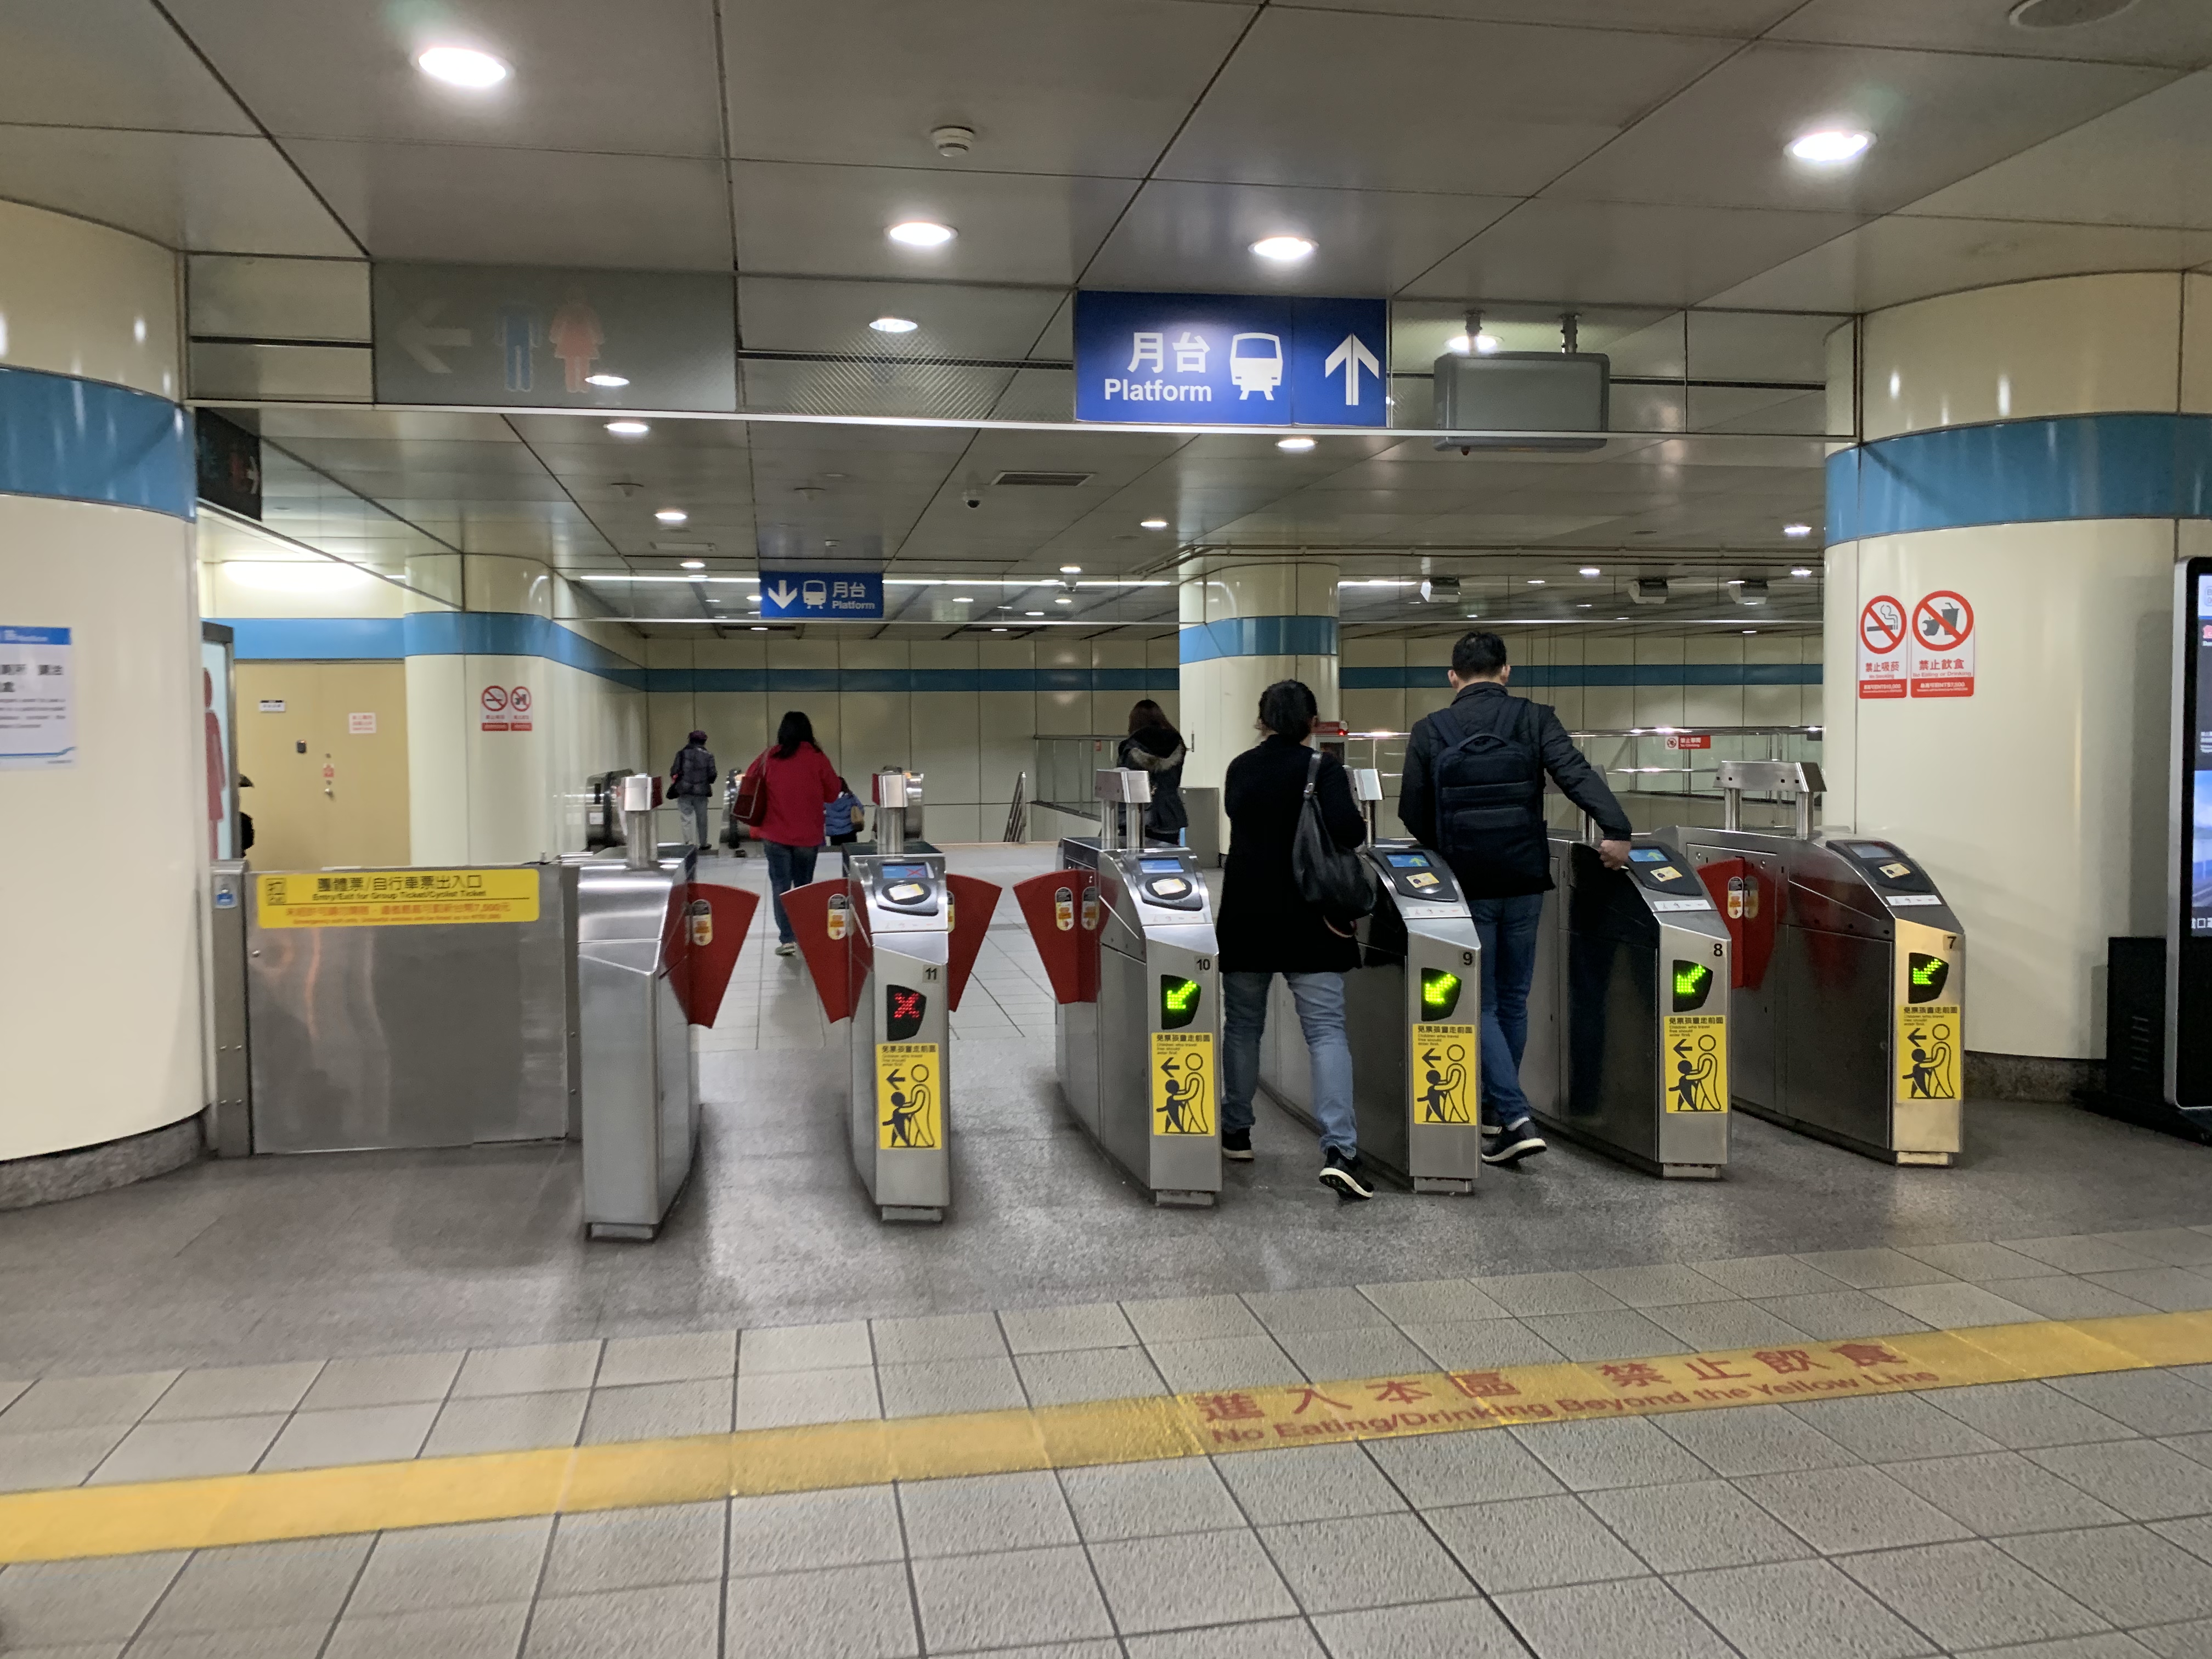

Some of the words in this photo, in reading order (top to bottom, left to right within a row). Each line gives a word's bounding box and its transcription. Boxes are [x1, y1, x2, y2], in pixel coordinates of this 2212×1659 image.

[1127, 331, 1211, 374] 月台
[1104, 379, 1211, 402] Platform
[832, 582, 866, 598] 月台
[832, 600, 875, 610] Platform
[1865, 661, 1900, 672] 禁止吸菸
[1919, 658, 1965, 670] 禁止飲食
[1947, 936, 1957, 949] 7
[1713, 943, 1723, 957] 8
[1197, 958, 1211, 971] 10
[1463, 951, 1473, 966] 9
[925, 967, 938, 981] 11
[1195, 1372, 1521, 1422] 進入本區
[1595, 1344, 1908, 1387] 禁止飲食
[1212, 1429, 1265, 1443] No
[1273, 1402, 1554, 1437] Eating/Drinking
[1555, 1391, 1690, 1412] Beyond
[1693, 1388, 1752, 1399] the
[1749, 1379, 1859, 1396] Yellow
[1861, 1372, 1939, 1386] Line
